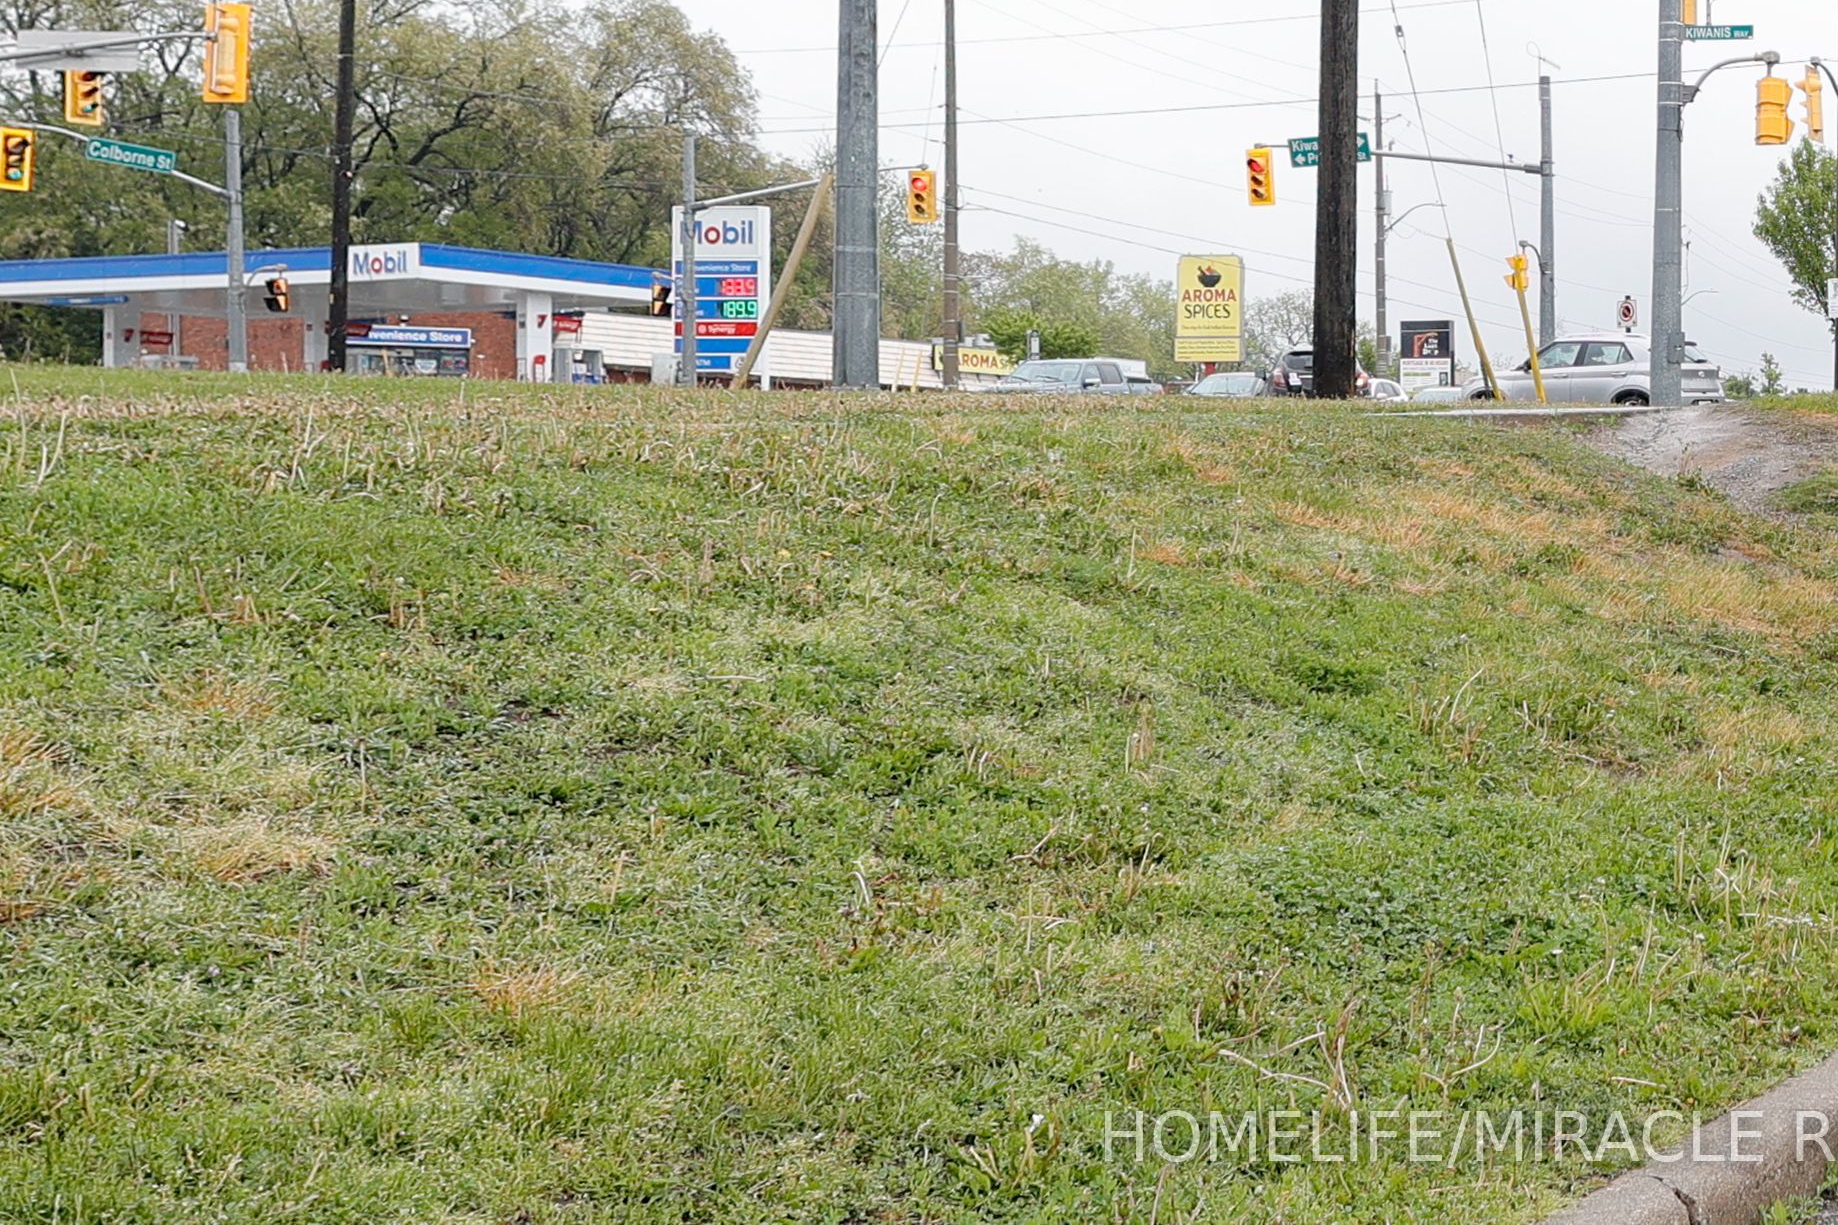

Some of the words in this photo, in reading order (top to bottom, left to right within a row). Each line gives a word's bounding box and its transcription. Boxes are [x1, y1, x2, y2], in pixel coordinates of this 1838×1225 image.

[1685, 27, 1732, 39] KIWANIS
[1291, 140, 1319, 152] Kiwa
[89, 141, 155, 167] Colborne
[156, 155, 171, 169] St
[353, 251, 407, 275] Mobil
[1181, 289, 1237, 302] AROMA
[1183, 303, 1231, 319] SPICES
[429, 330, 463, 343] Store
[960, 353, 999, 369] ROMA
